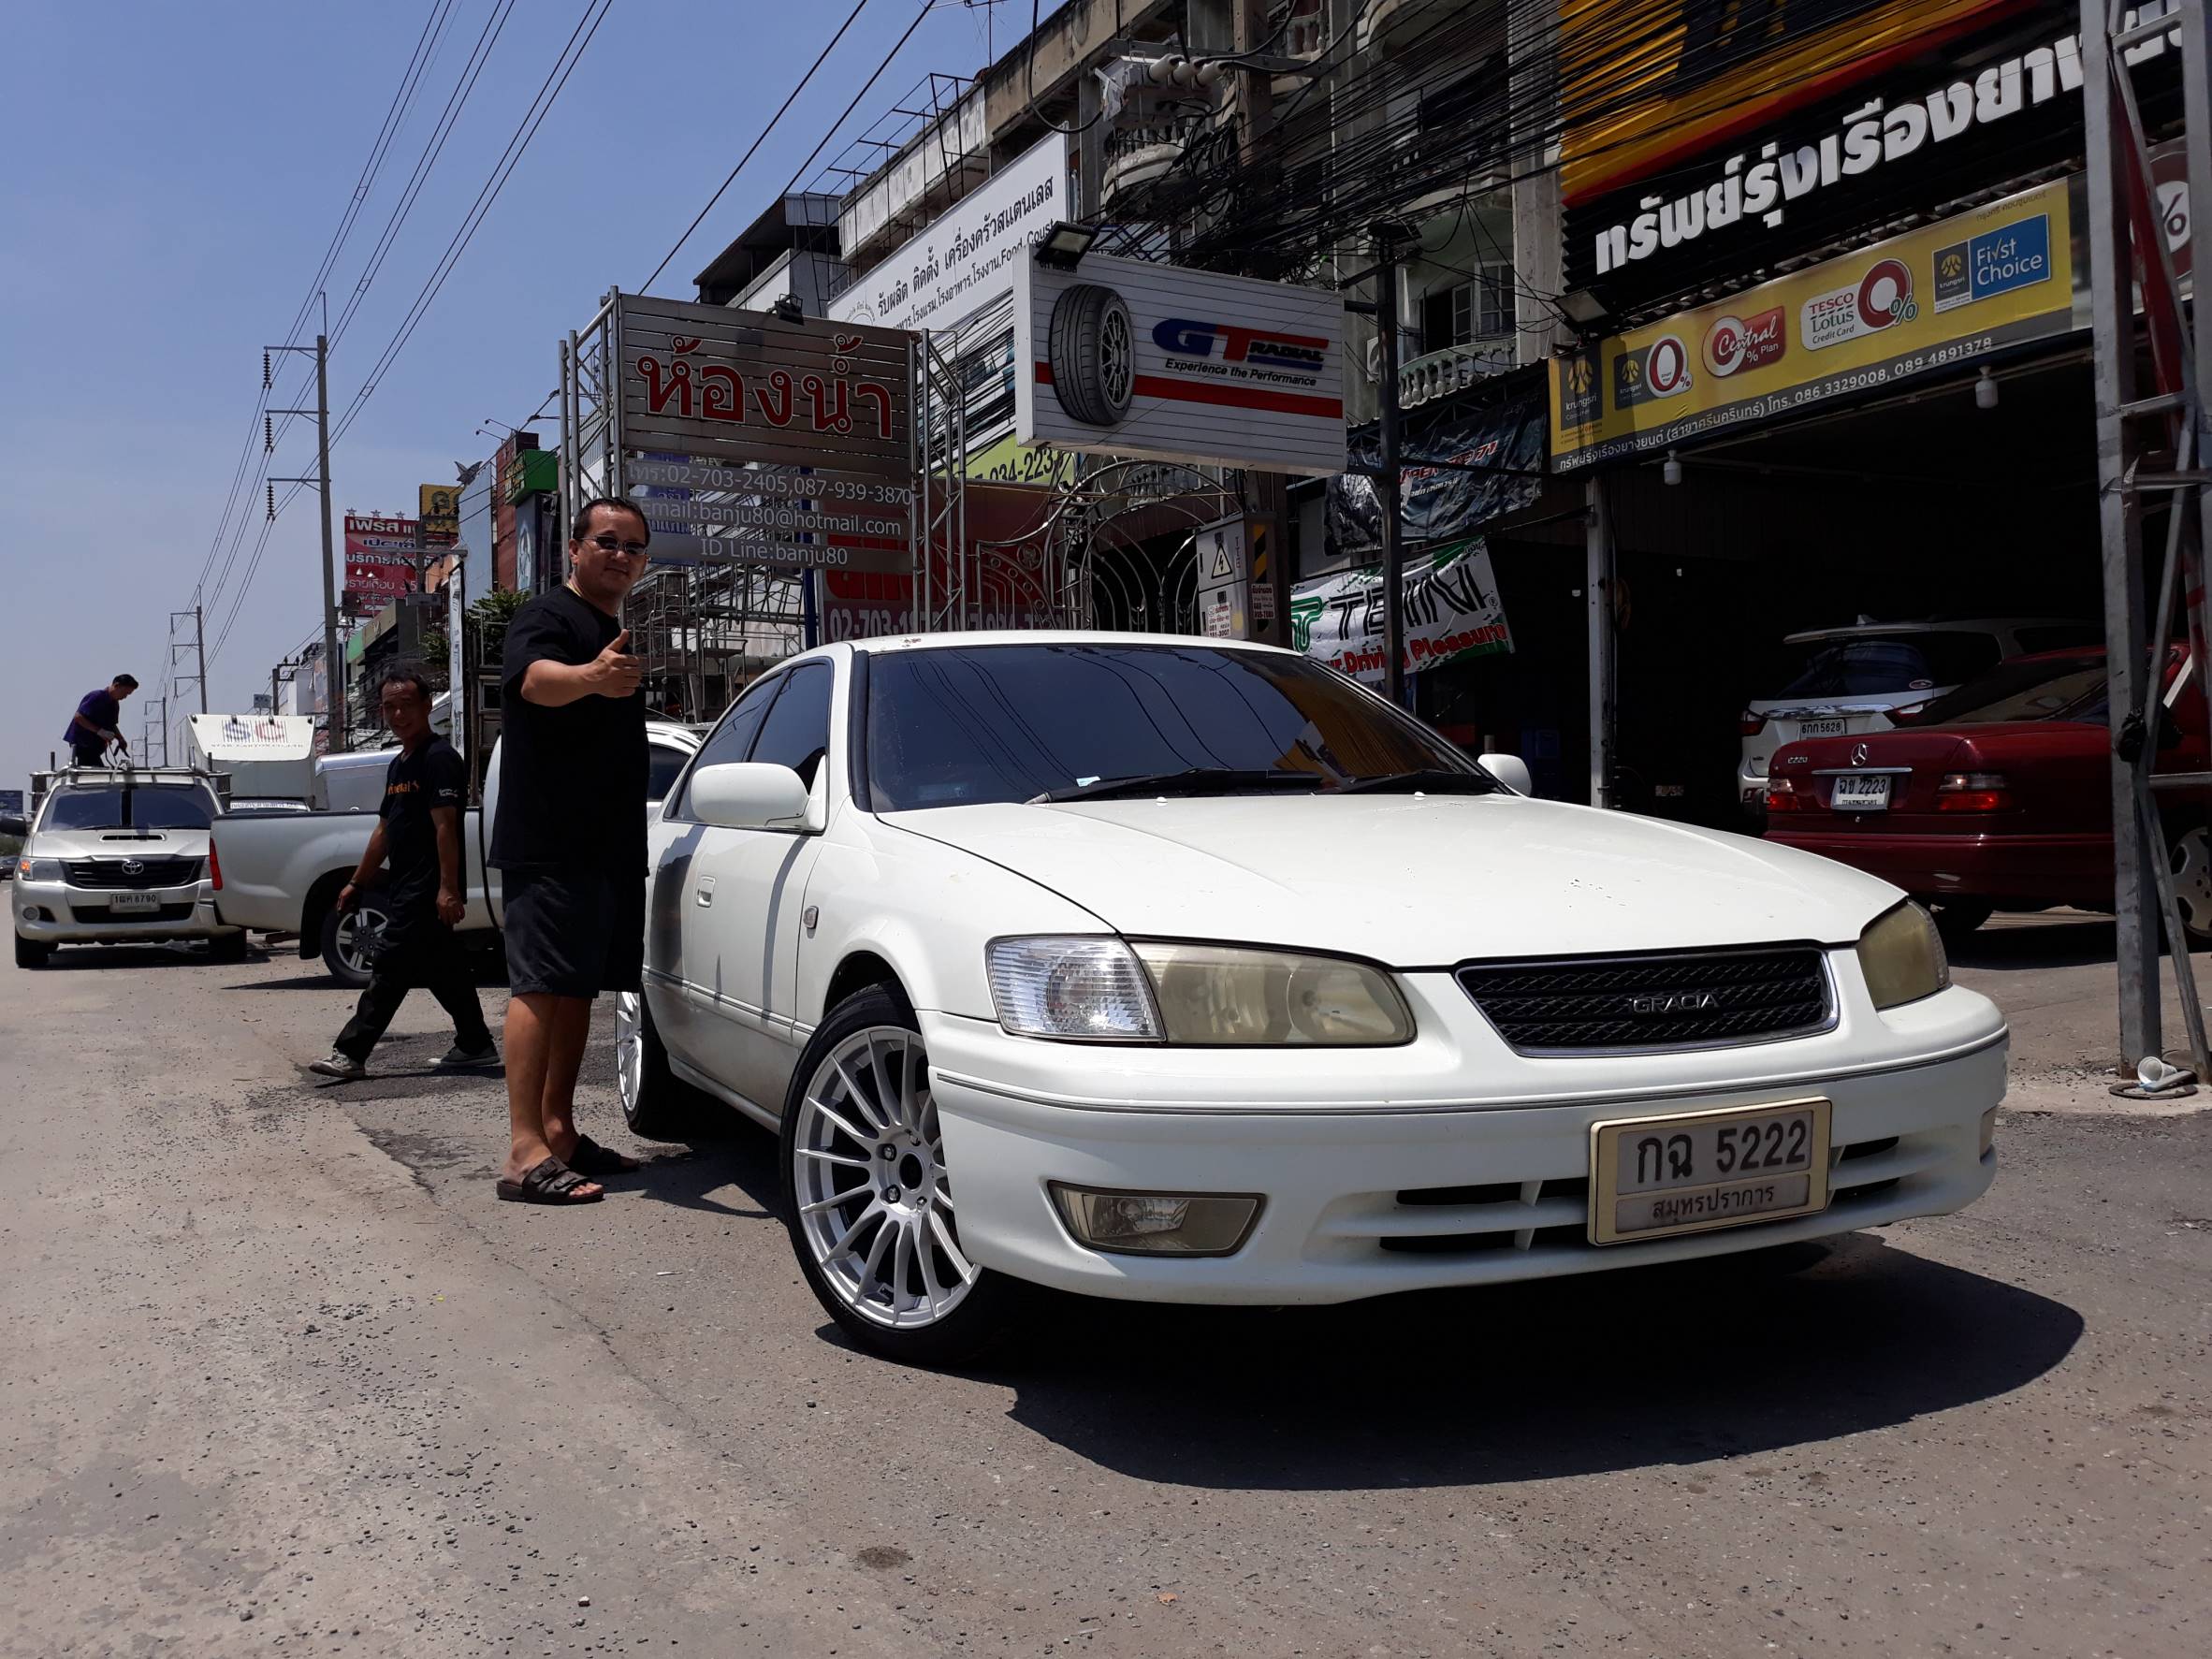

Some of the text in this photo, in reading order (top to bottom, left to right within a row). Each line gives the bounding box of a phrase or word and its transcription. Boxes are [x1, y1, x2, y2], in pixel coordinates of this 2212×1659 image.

[878, 280, 908, 317] รับผลิต
[912, 245, 939, 293] ติดตั้ง
[944, 176, 1055, 270] เครื่องครัวสแตนเลส
[1976, 255, 2044, 285] Choice
[1809, 292, 1855, 314] TESCO
[1718, 315, 1777, 356] Central
[1812, 310, 1855, 333] Lotus
[1812, 325, 1855, 344] Credit Card
[1152, 318, 1330, 361] GT
[1249, 341, 1325, 363] RADIAL
[1760, 342, 1779, 354] Plan
[1165, 357, 1317, 386] Experience the Performance
[1768, 395, 1793, 415] โทร.
[1795, 386, 1821, 404] 086
[1825, 368, 1890, 397] 3329008,
[1894, 356, 1924, 376] 089
[1928, 337, 1993, 369] 4891378
[636, 333, 893, 440] ห้องน้ำ
[1564, 394, 1598, 412] krungsri
[640, 498, 902, 537] Email:banju80@hotmail.com
[701, 538, 848, 566] ID Line:banju80
[1409, 623, 1508, 662] Pleasure
[1820, 721, 1841, 733] 5628
[1858, 778, 1886, 795] 2223
[1633, 992, 1720, 1014] GRACIA
[1637, 1118, 1807, 1184] กฉ 5222
[1652, 1183, 1774, 1220] สมุทรปราการ
